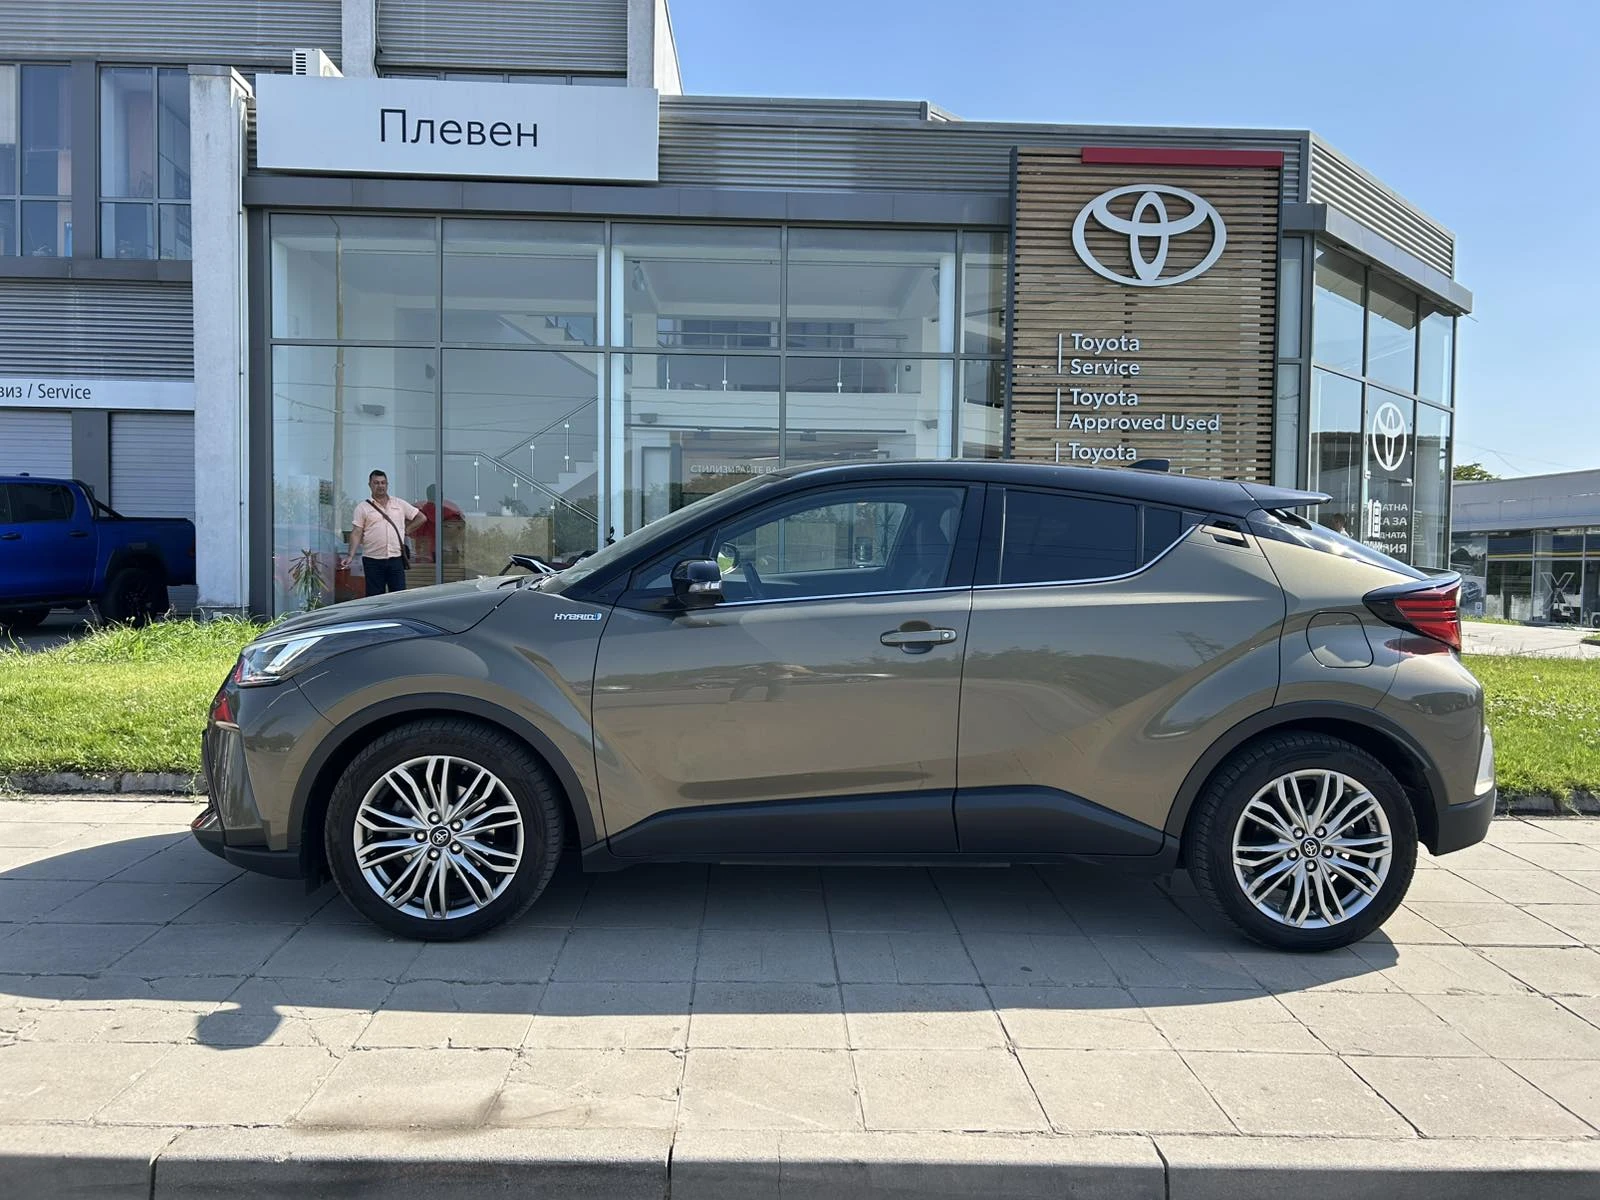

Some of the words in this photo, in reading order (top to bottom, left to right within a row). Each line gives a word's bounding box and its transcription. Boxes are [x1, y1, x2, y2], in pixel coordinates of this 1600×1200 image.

[380, 108, 538, 147] Плевен
[1071, 333, 1140, 355] Toyota
[1070, 358, 1140, 375] Service
[37, 383, 91, 400] Service
[1069, 388, 1139, 410] Toyota
[1069, 413, 1166, 433] Approved
[1171, 414, 1220, 431] Used
[1068, 442, 1137, 464] Toyota
[554, 613, 595, 621] HYBRID
